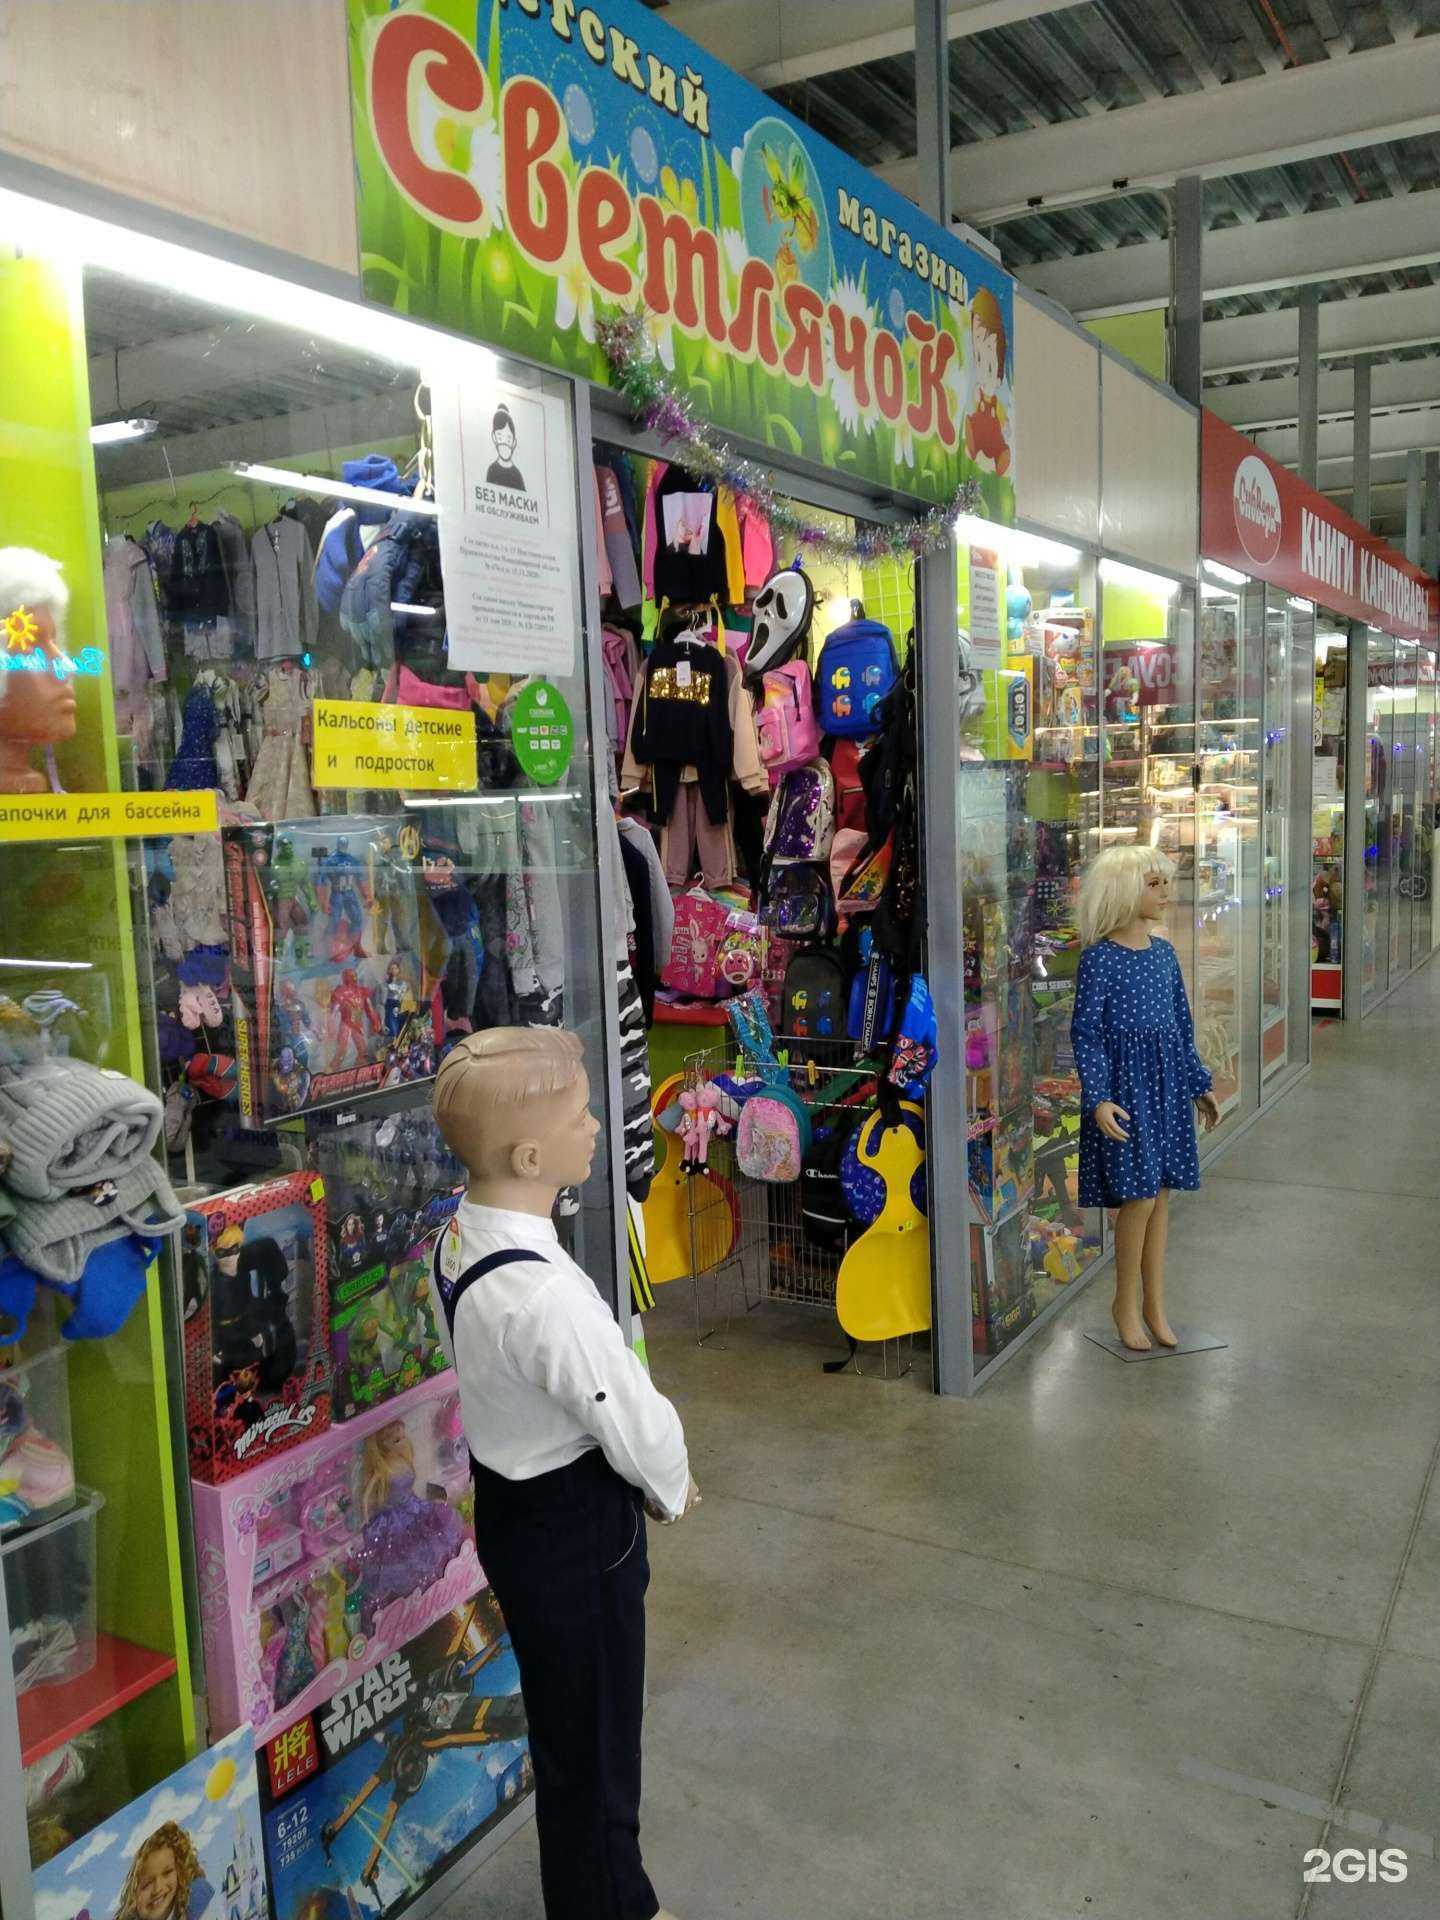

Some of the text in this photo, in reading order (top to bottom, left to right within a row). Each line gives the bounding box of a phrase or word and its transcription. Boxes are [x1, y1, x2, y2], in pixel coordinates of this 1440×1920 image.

[499, 0, 711, 136] тский
[368, 12, 960, 449] Светлячок
[835, 187, 968, 305] магазин
[475, 486, 538, 513] БЕЗ МАСКИ
[475, 504, 485, 514] НЕ
[1302, 506, 1354, 596] КНИГИ
[317, 709, 462, 736] Кальсоны детские
[327, 754, 435, 773] и подросток
[77, 806, 110, 824] для
[125, 802, 201, 819] бассейна
[321, 1650, 411, 1731] STAR
[277, 1756, 314, 1789] LELE
[277, 1805, 309, 1839] 6-12
